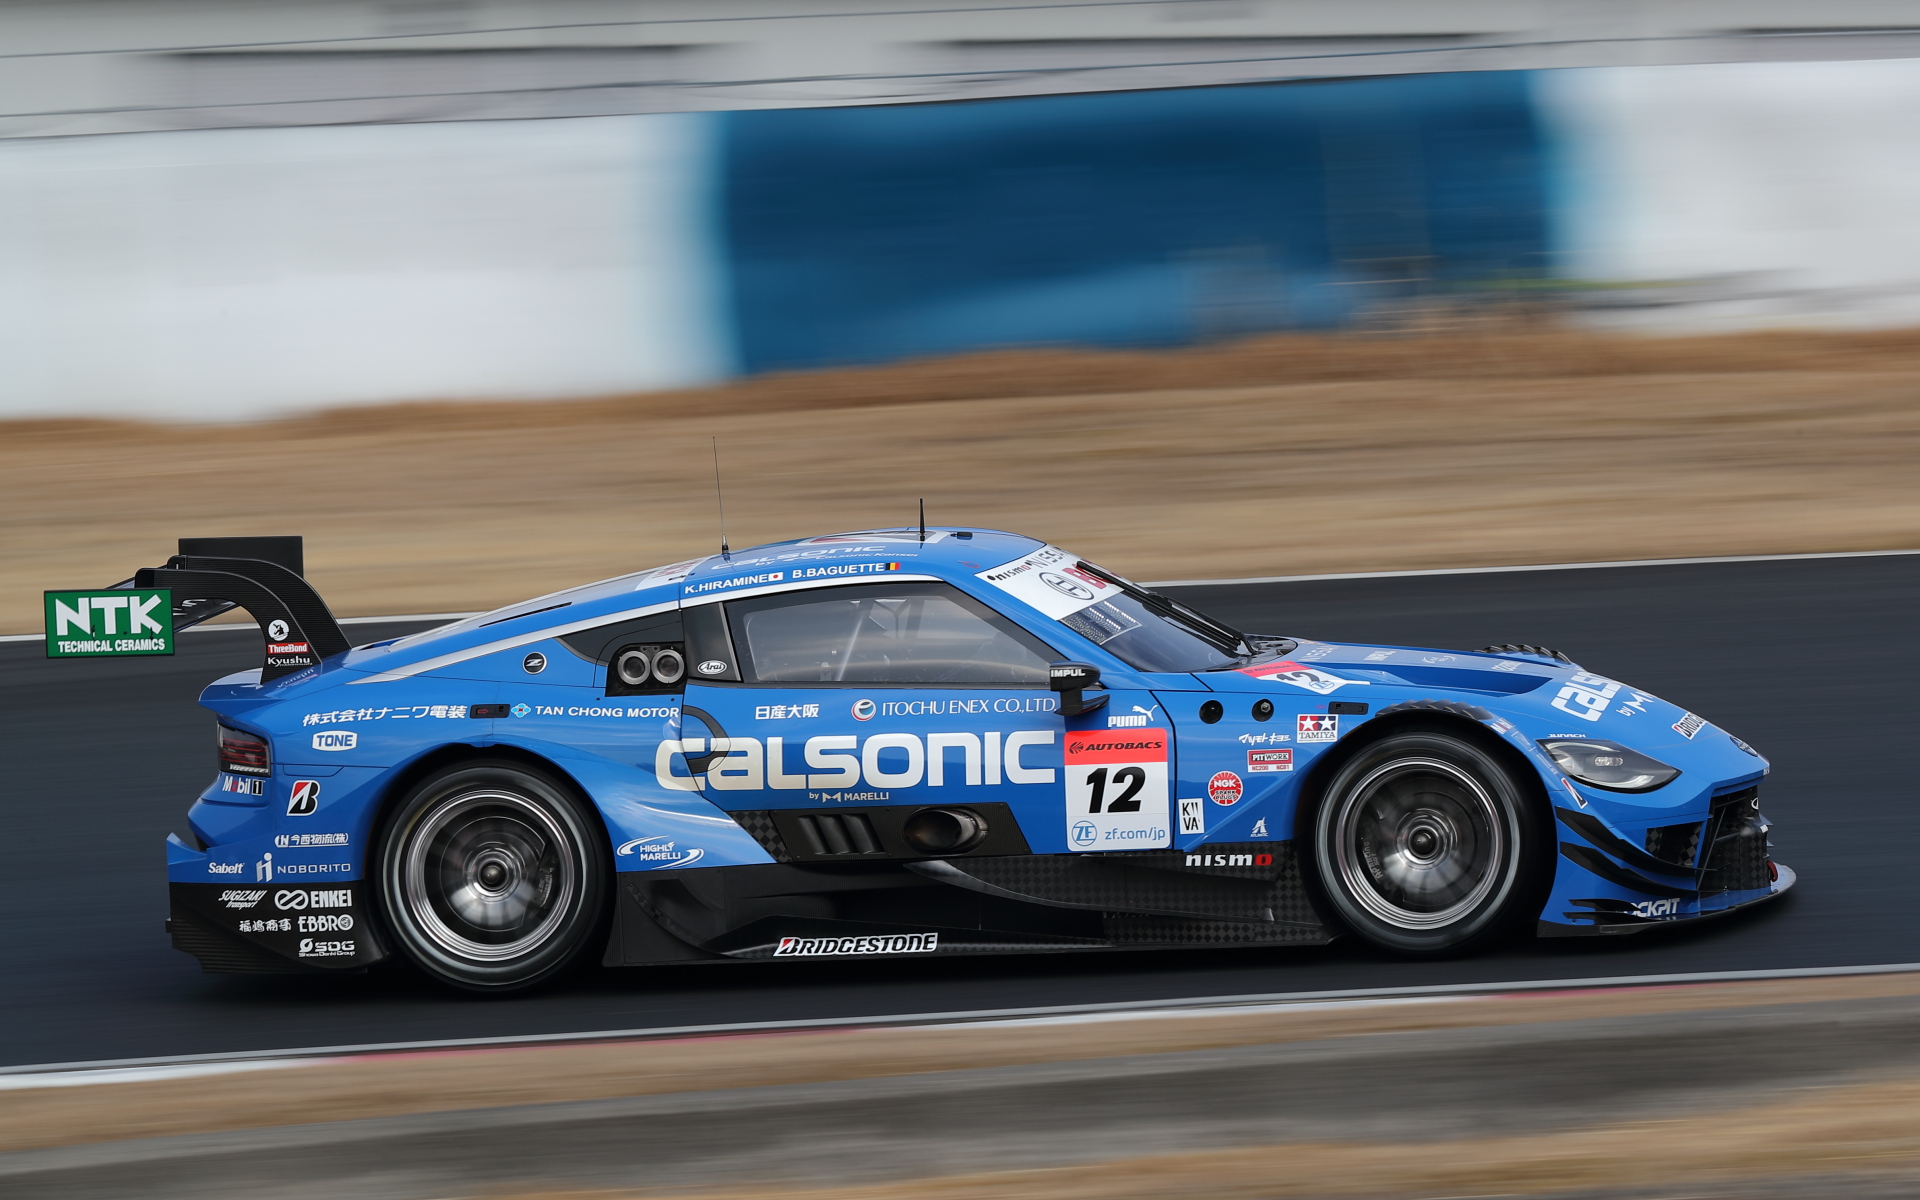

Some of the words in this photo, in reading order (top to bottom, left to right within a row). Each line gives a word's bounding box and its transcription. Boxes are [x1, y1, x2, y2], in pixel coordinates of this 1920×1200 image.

[684, 573, 769, 595] K.HIRAMINE
[792, 562, 885, 579] B.BAGUETTE
[994, 564, 1031, 581] nismo
[55, 594, 163, 636] NTK
[58, 641, 113, 654] TECHNICAL
[114, 637, 165, 652] CERAMICS
[268, 643, 307, 654] ThreeBond
[267, 655, 310, 668] Kyushu
[700, 662, 723, 671] Arai
[1051, 668, 1086, 678] IMPUL
[535, 705, 564, 716] TAN
[568, 706, 624, 718] CHONG
[627, 706, 680, 718] MOTOR
[754, 703, 820, 720] 日産大阪
[882, 699, 946, 716] ITOCHU
[949, 699, 989, 715] ENEX
[303, 705, 468, 727] 株式会社ナニワ電装
[1107, 715, 1147, 728] PUMA
[316, 735, 354, 747] TONE
[1085, 741, 1163, 752] AUTOBACS
[222, 775, 251, 795] Mobil
[1086, 766, 1146, 814] 12
[1213, 779, 1237, 788] NGK
[809, 791, 819, 800] by
[844, 791, 889, 801] MARELLI
[1105, 827, 1166, 841] zf.com/jp
[640, 842, 675, 852] HIGHLY
[640, 852, 681, 861] MARELLI
[1185, 854, 1273, 867] nismo
[208, 862, 244, 874] Sabelt
[277, 863, 351, 874] NOBORITO
[217, 890, 268, 901] SUGIZAKI
[310, 890, 353, 908] ENKEI
[1624, 898, 1680, 917] CKPIT
[297, 914, 354, 933] EBBRO
[315, 940, 355, 952] SDG
[774, 933, 938, 956] BRIDGESTONE
